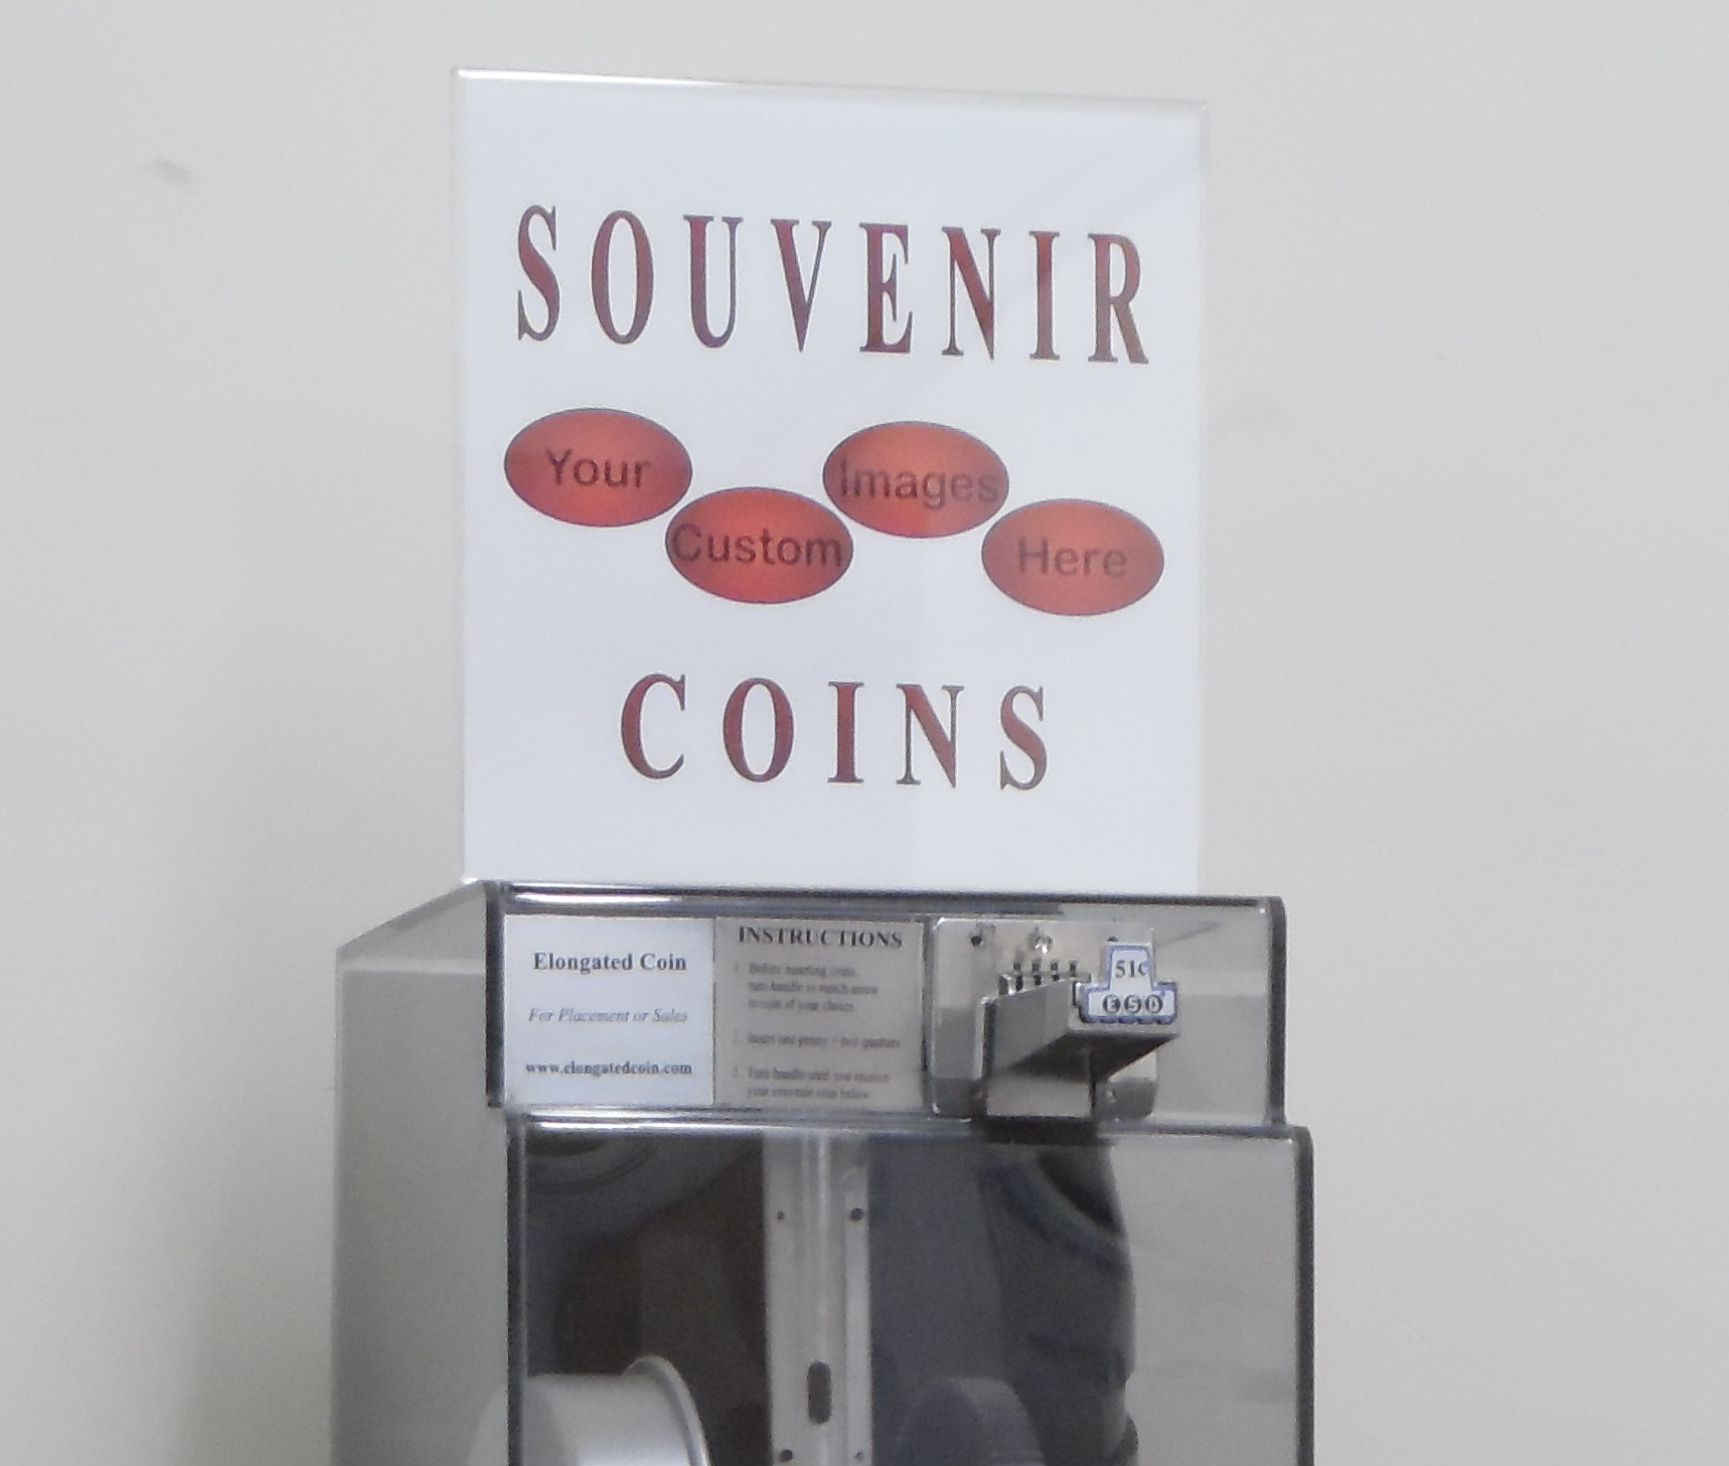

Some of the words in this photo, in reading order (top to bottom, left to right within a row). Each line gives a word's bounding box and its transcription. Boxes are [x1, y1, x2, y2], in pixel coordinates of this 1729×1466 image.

[516, 203, 1150, 365] SOUVENIR
[545, 447, 651, 492] Your
[839, 458, 999, 511] Images
[672, 523, 843, 569] Custom
[1016, 536, 1128, 579] Here
[620, 671, 1048, 791] COINS
[738, 925, 904, 949] INSTRUCTIONS
[533, 952, 634, 975] Elongated
[640, 953, 688, 971] Coin
[528, 1008, 554, 1023] For
[558, 1008, 630, 1023] Placement
[633, 1010, 649, 1023] or
[653, 1008, 689, 1023] Sales
[526, 1061, 693, 1077] www.elongatedcoin.com
